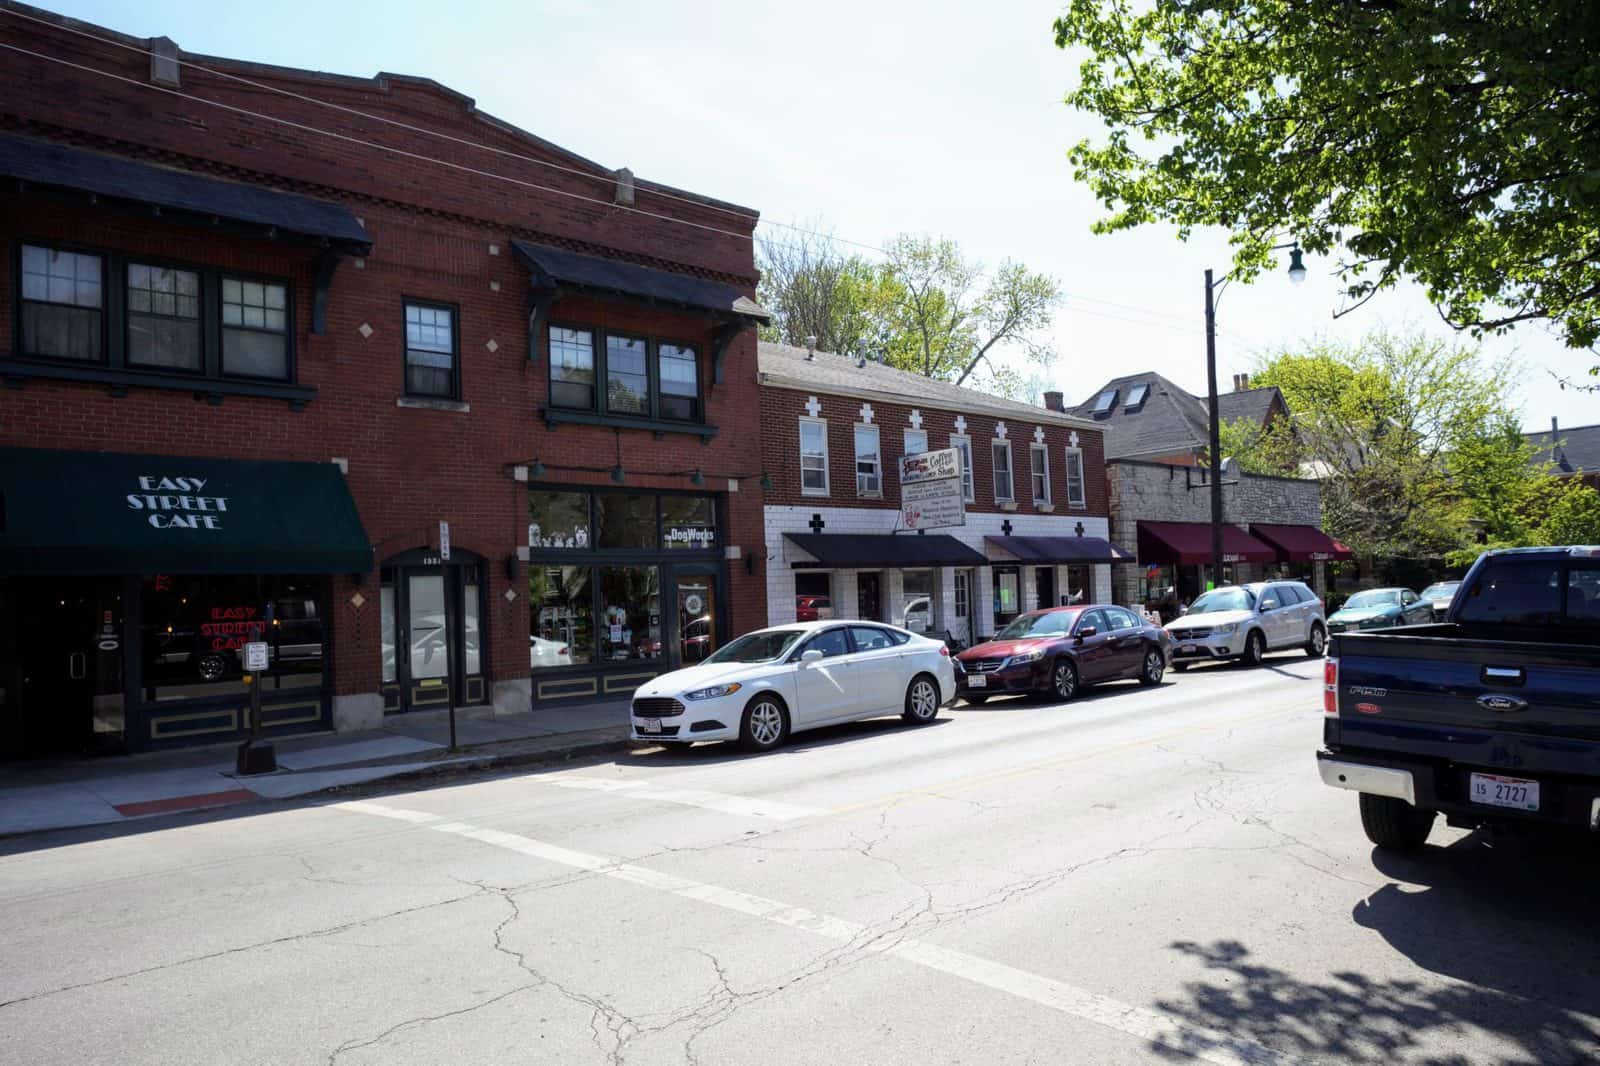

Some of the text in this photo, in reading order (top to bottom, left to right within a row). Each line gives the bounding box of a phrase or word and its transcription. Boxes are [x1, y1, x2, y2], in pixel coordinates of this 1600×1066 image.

[138, 476, 208, 492] EASY
[127, 494, 232, 511] STREET
[148, 514, 223, 529] CAFE
[210, 608, 257, 619] EASY
[211, 637, 247, 650] CAF
[1496, 784, 1527, 802] 2727
